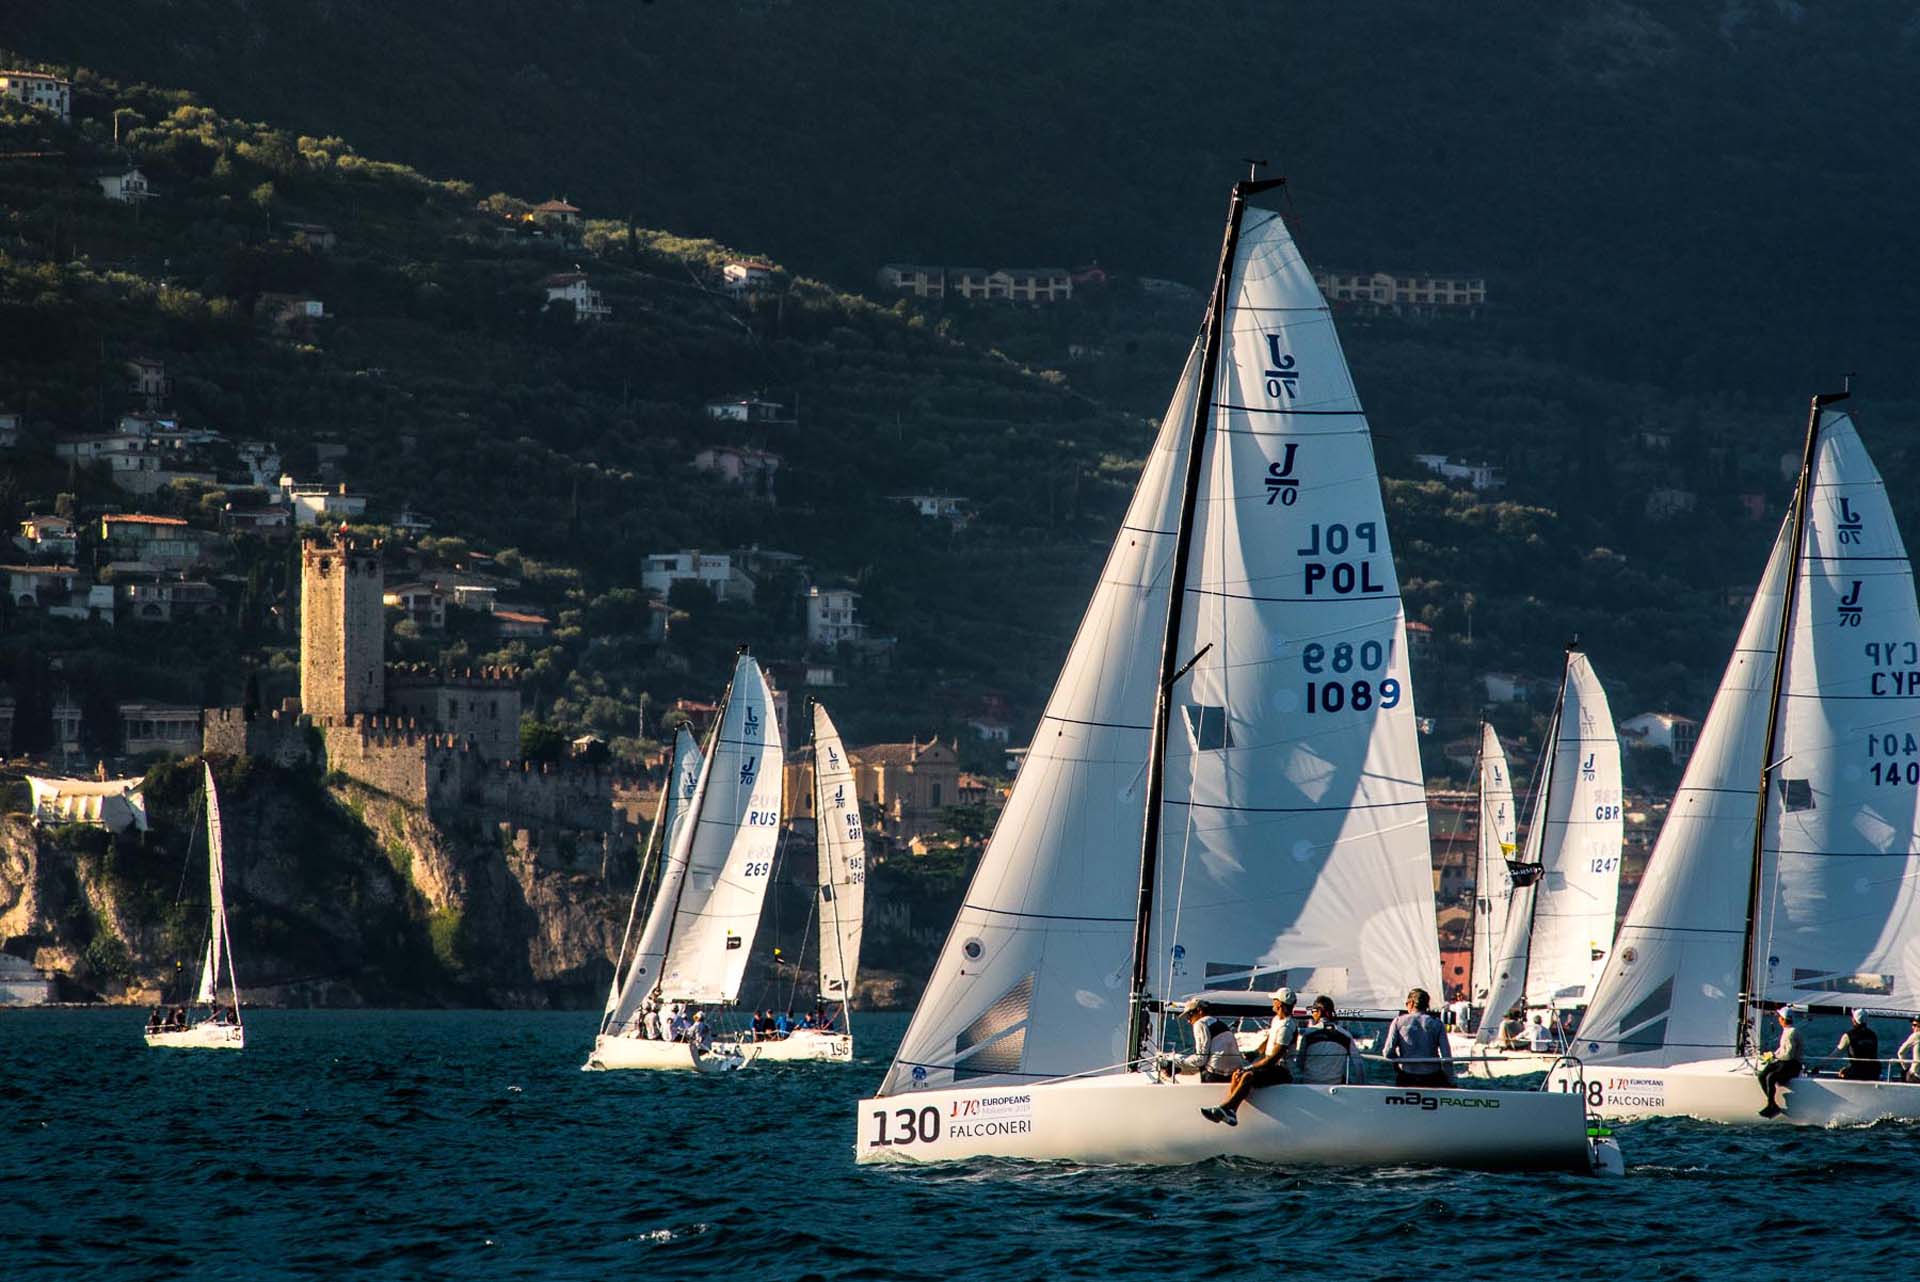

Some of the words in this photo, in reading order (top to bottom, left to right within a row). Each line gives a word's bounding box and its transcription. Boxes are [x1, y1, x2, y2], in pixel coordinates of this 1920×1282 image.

[1269, 443, 1299, 477] J
[1266, 487, 1297, 506] 70
[1305, 561, 1383, 595] POL
[1841, 581, 1862, 606] J
[1839, 613, 1861, 627] 70
[1872, 672, 1920, 696] CYP
[1307, 678, 1400, 713] 1089
[742, 757, 755, 771] J
[1584, 754, 1595, 769] J
[740, 775, 753, 784] 70
[1583, 773, 1594, 782] 70
[750, 811, 776, 826] RUS
[1596, 806, 1619, 820] GBR
[745, 862, 768, 877] 269
[1591, 858, 1618, 873] 1247
[831, 1042, 848, 1056] 196
[982, 1095, 1031, 1107] EUROPEANS
[1440, 1097, 1500, 1108] RACING
[1608, 1095, 1664, 1107] FALCONERI
[870, 1107, 940, 1147] 130
[950, 1120, 1031, 1138] FALCONERI
